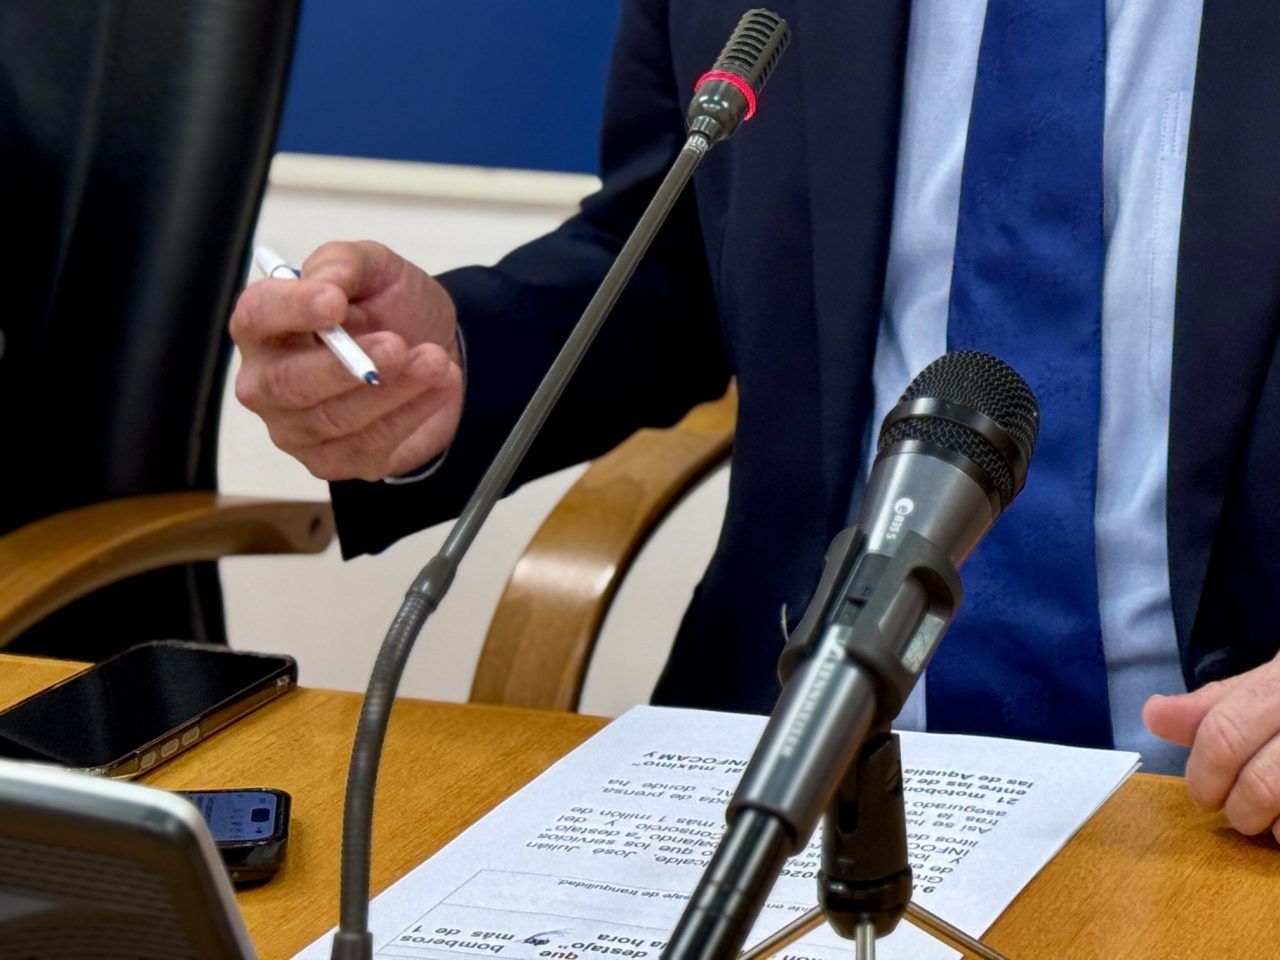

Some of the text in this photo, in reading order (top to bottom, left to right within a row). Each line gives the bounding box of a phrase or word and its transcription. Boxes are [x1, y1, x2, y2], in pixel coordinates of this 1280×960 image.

[778, 658, 838, 759] SENNHEISER
[658, 754, 749, 767] INFOCAM
[903, 768, 975, 781] Aqualia
[608, 779, 631, 787] ha
[917, 778, 941, 786] de
[946, 780, 974, 790] las
[978, 776, 1003, 784] de
[1006, 779, 1035, 789] las
[641, 782, 697, 793] donde
[978, 784, 1027, 796] entre
[669, 793, 692, 801] de
[996, 796, 1020, 806] 21
[570, 806, 593, 816] de
[912, 801, 1008, 817] asegurado
[556, 815, 588, 825] del
[600, 810, 651, 820] millón
[937, 813, 954, 821] la
[603, 818, 618, 827] y
[676, 817, 715, 828] más
[933, 821, 955, 829] se
[965, 816, 999, 827] tras
[960, 824, 992, 835] Así
[537, 833, 617, 847] servicios
[907, 833, 979, 848] litros de
[525, 841, 581, 853] Julián
[624, 840, 651, 851] los
[908, 842, 970, 857] INFOC
[592, 848, 637, 858] José
[658, 845, 694, 857] que
[948, 857, 963, 865] y
[930, 865, 954, 875] de
[412, 925, 423, 934] 1
[435, 928, 461, 937] de
[471, 931, 515, 941] más
[596, 933, 645, 948] hora
[400, 935, 504, 954] bomberos
